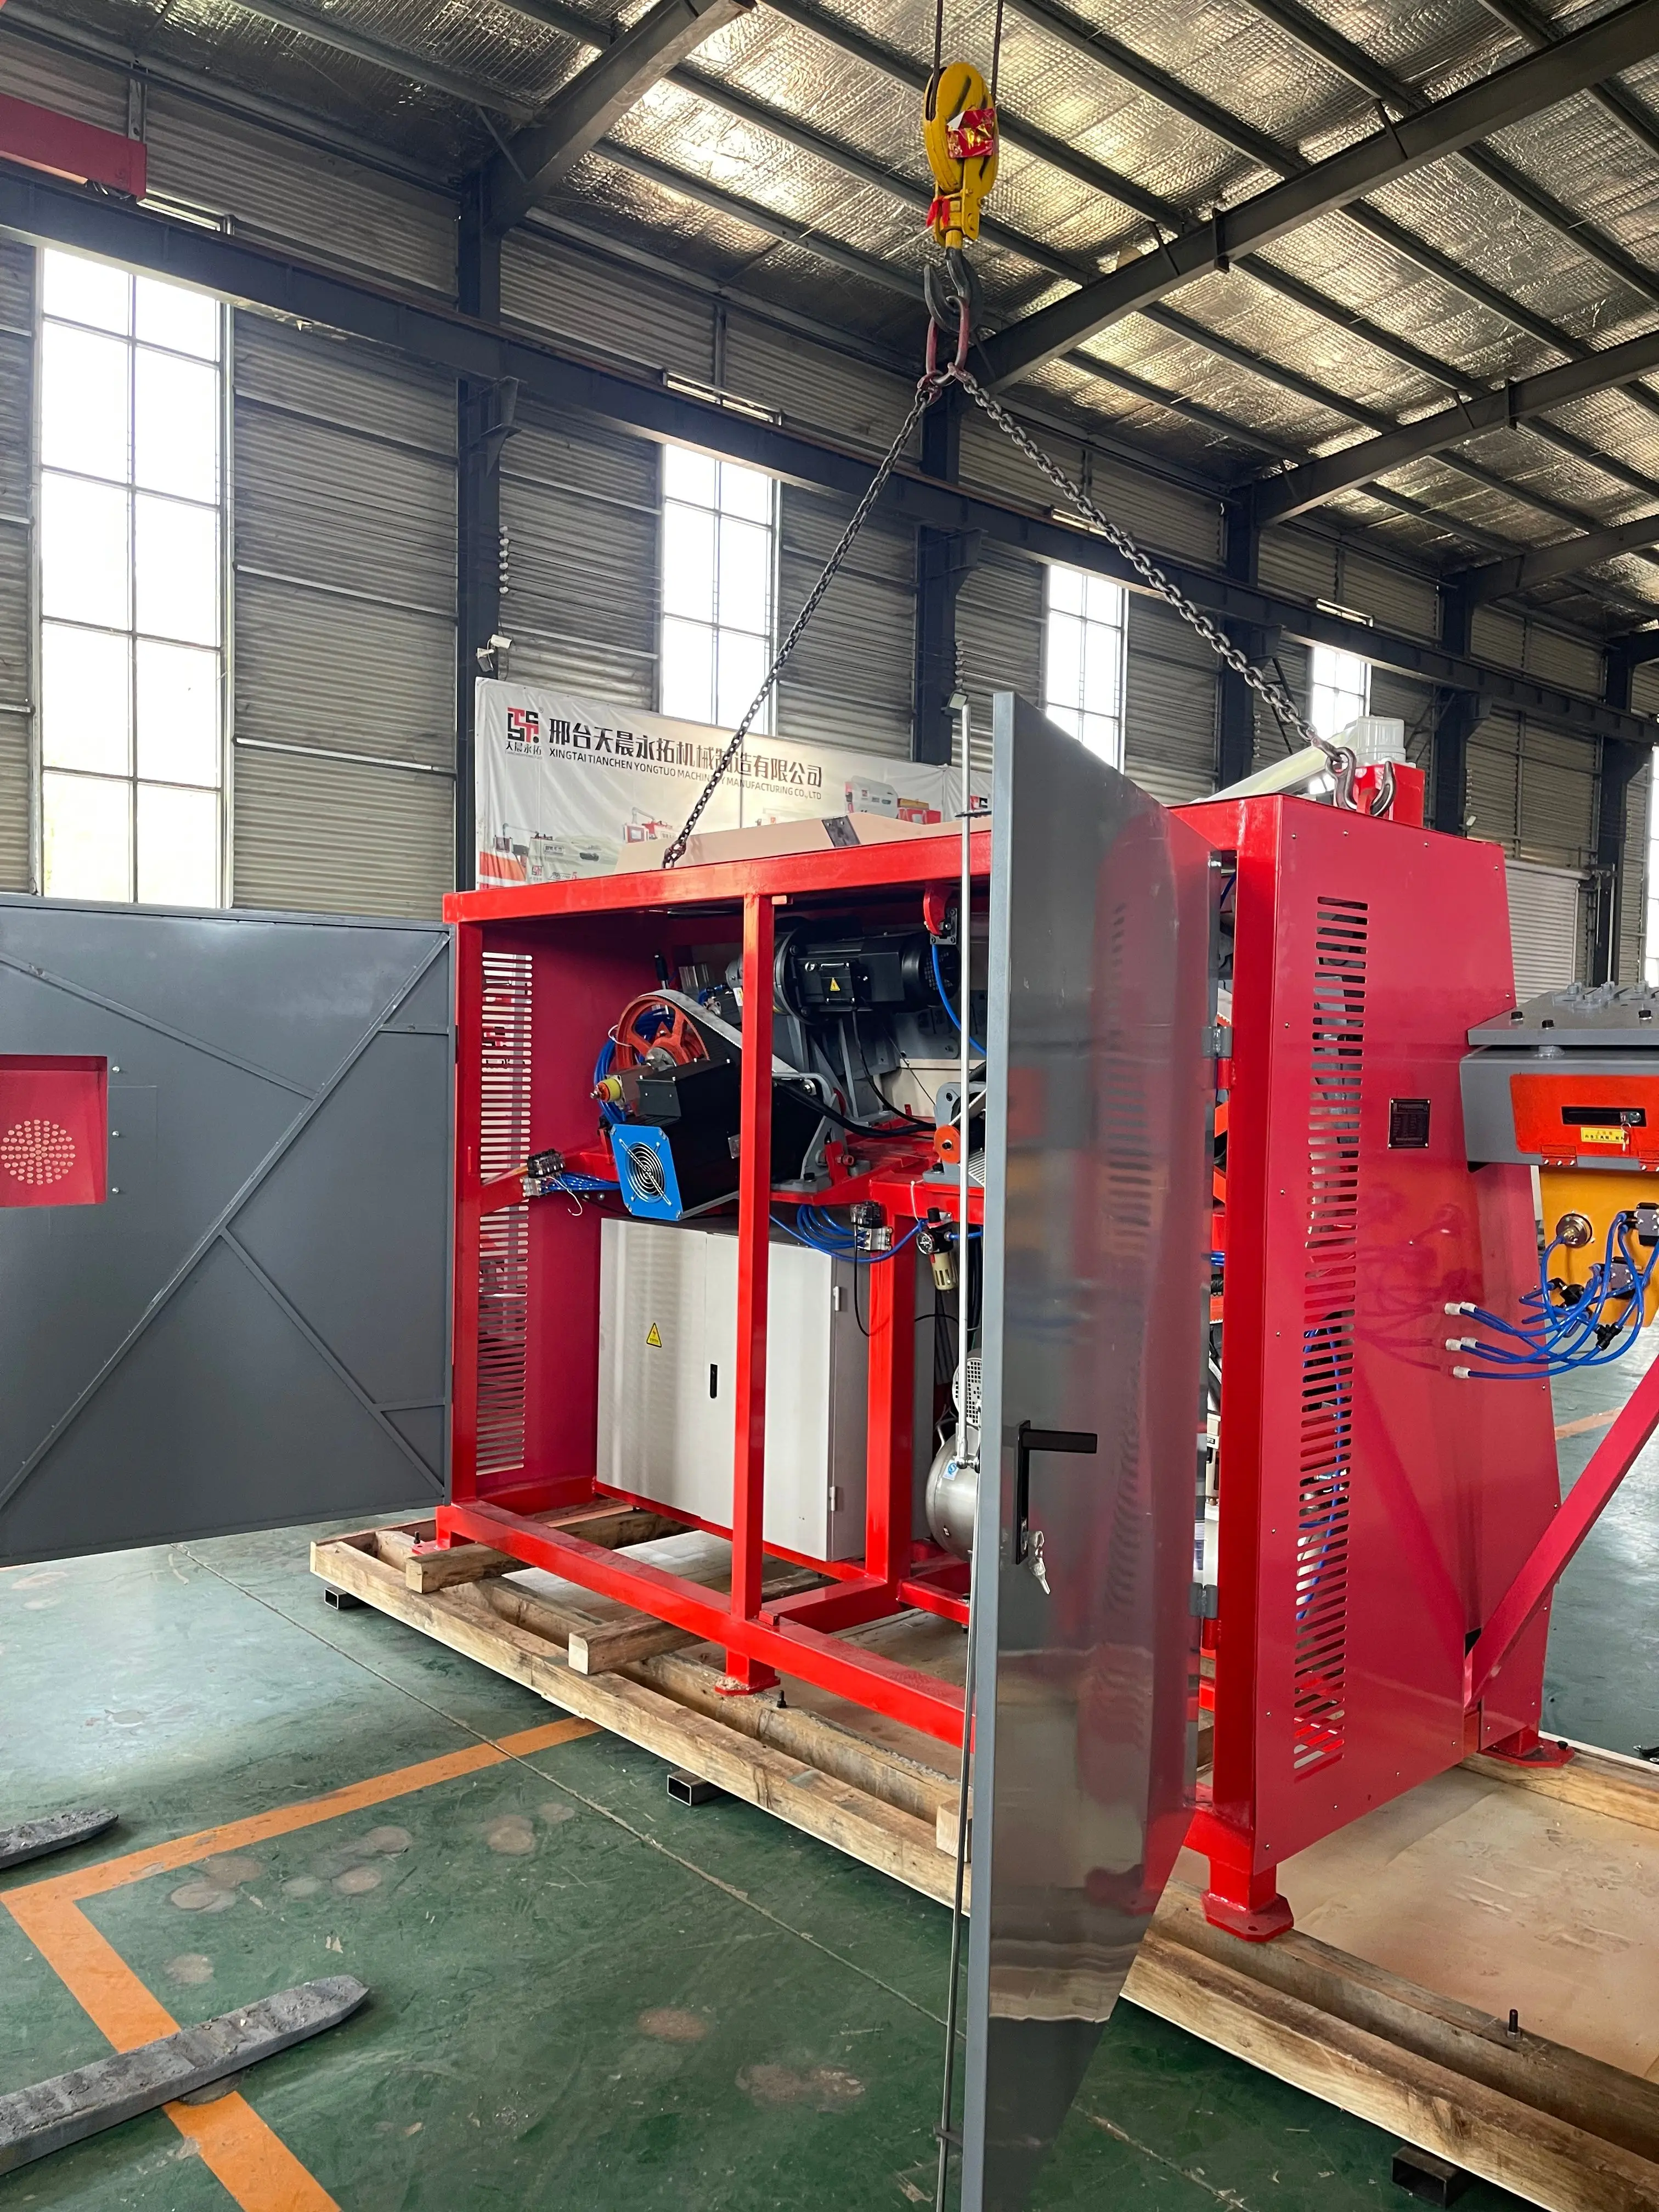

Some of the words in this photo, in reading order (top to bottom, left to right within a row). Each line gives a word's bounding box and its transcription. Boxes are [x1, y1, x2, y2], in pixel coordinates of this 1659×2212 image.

[550, 747, 586, 763] XINGTAI
[588, 754, 633, 770] TIANCHEN
[634, 762, 676, 777] YONGTUO
[677, 769, 725, 785] MACHINY
[726, 777, 793, 796] MANUFACTURING
